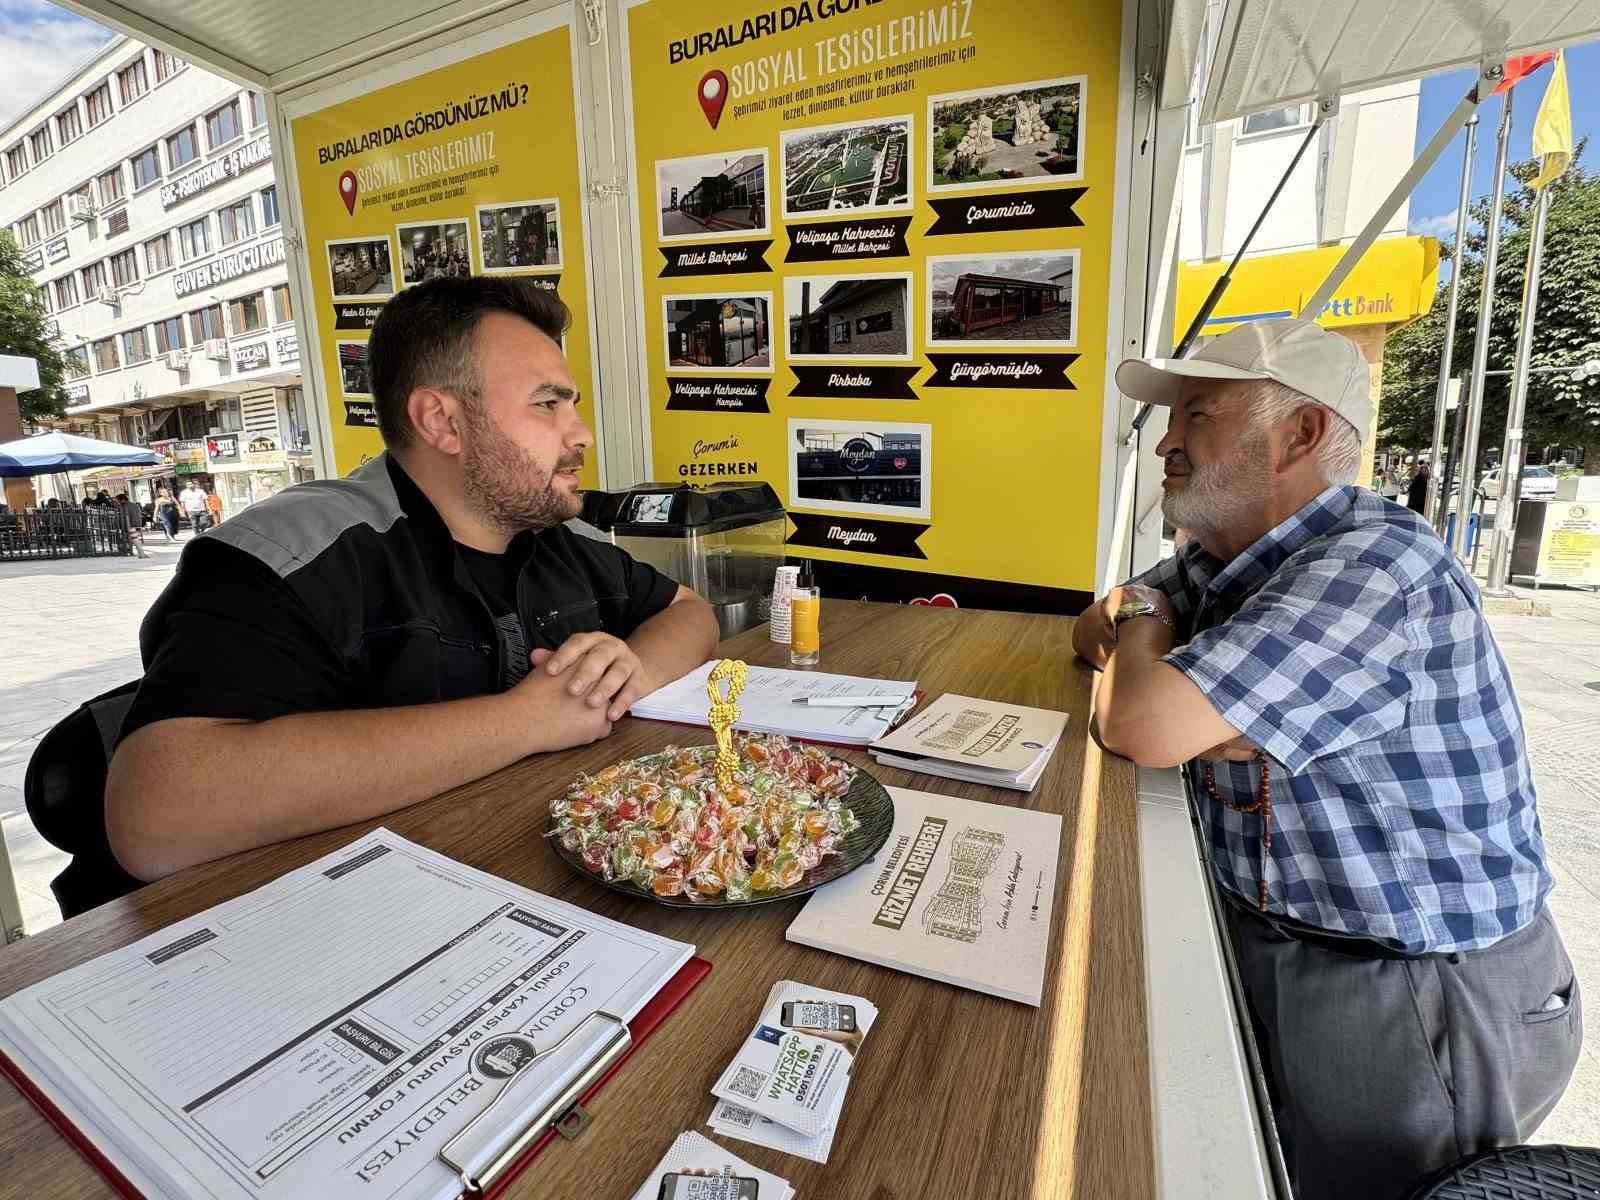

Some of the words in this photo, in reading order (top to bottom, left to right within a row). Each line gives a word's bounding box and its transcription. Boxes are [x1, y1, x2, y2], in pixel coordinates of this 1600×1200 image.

[669, 13, 777, 64] BURALARI
[780, 4, 814, 32] DA
[731, 48, 807, 99] SOSYAL
[815, 0, 974, 77] TESİSLERİMİZ
[733, 100, 767, 120] Şehrimizi
[768, 94, 794, 109] ziyaret
[795, 88, 814, 102] eden
[816, 72, 872, 96] misafirlerimiz
[874, 68, 883, 80] ve
[958, 45, 976, 63] için
[849, 87, 874, 105] kültür
[876, 79, 915, 98] durakları
[318, 128, 382, 165] BURALARI
[383, 120, 404, 145] DA
[405, 95, 490, 138] GÖRDÜNÜZ
[357, 157, 403, 193] SOSYAL
[406, 132, 497, 179] TESİSLERİMİZ
[966, 201, 1035, 225] Çoruminia
[796, 230, 840, 245] Velipaşa
[841, 224, 896, 240] Kahvecisi
[832, 243, 857, 254] Millet
[857, 240, 891, 254] Bahçesi
[678, 250, 707, 266] Millet
[708, 248, 748, 265] Bahçesi
[827, 373, 873, 387] Pirbaba
[950, 361, 1042, 381] Güngörmüşler
[675, 383, 712, 397] Velipaşa
[713, 383, 758, 396] Kahvecisi
[678, 462, 758, 476] GEZERKEN
[840, 448, 876, 465] Meydan
[827, 525, 877, 546] Meydan
[870, 869, 894, 896] ÇORUM
[884, 835, 910, 869] BELEDİYESİ
[877, 870, 923, 925] HİZMET
[903, 820, 944, 873] REHBERİ
[525, 961, 570, 993] GÖNÜL
[482, 994, 528, 1031] KAPISI
[524, 986, 588, 1039] ÇORUM
[406, 1030, 484, 1090] BAŞVURU
[768, 1035, 800, 1099] WHATSAPP
[785, 1059, 807, 1094] HATTI
[796, 1080, 810, 1101] 0501
[804, 1064, 815, 1079] 100
[811, 1054, 819, 1063] 19
[815, 1045, 824, 1053] 19
[337, 1090, 406, 1145] FORMU
[354, 1079, 484, 1184] BELEDİYESİ
